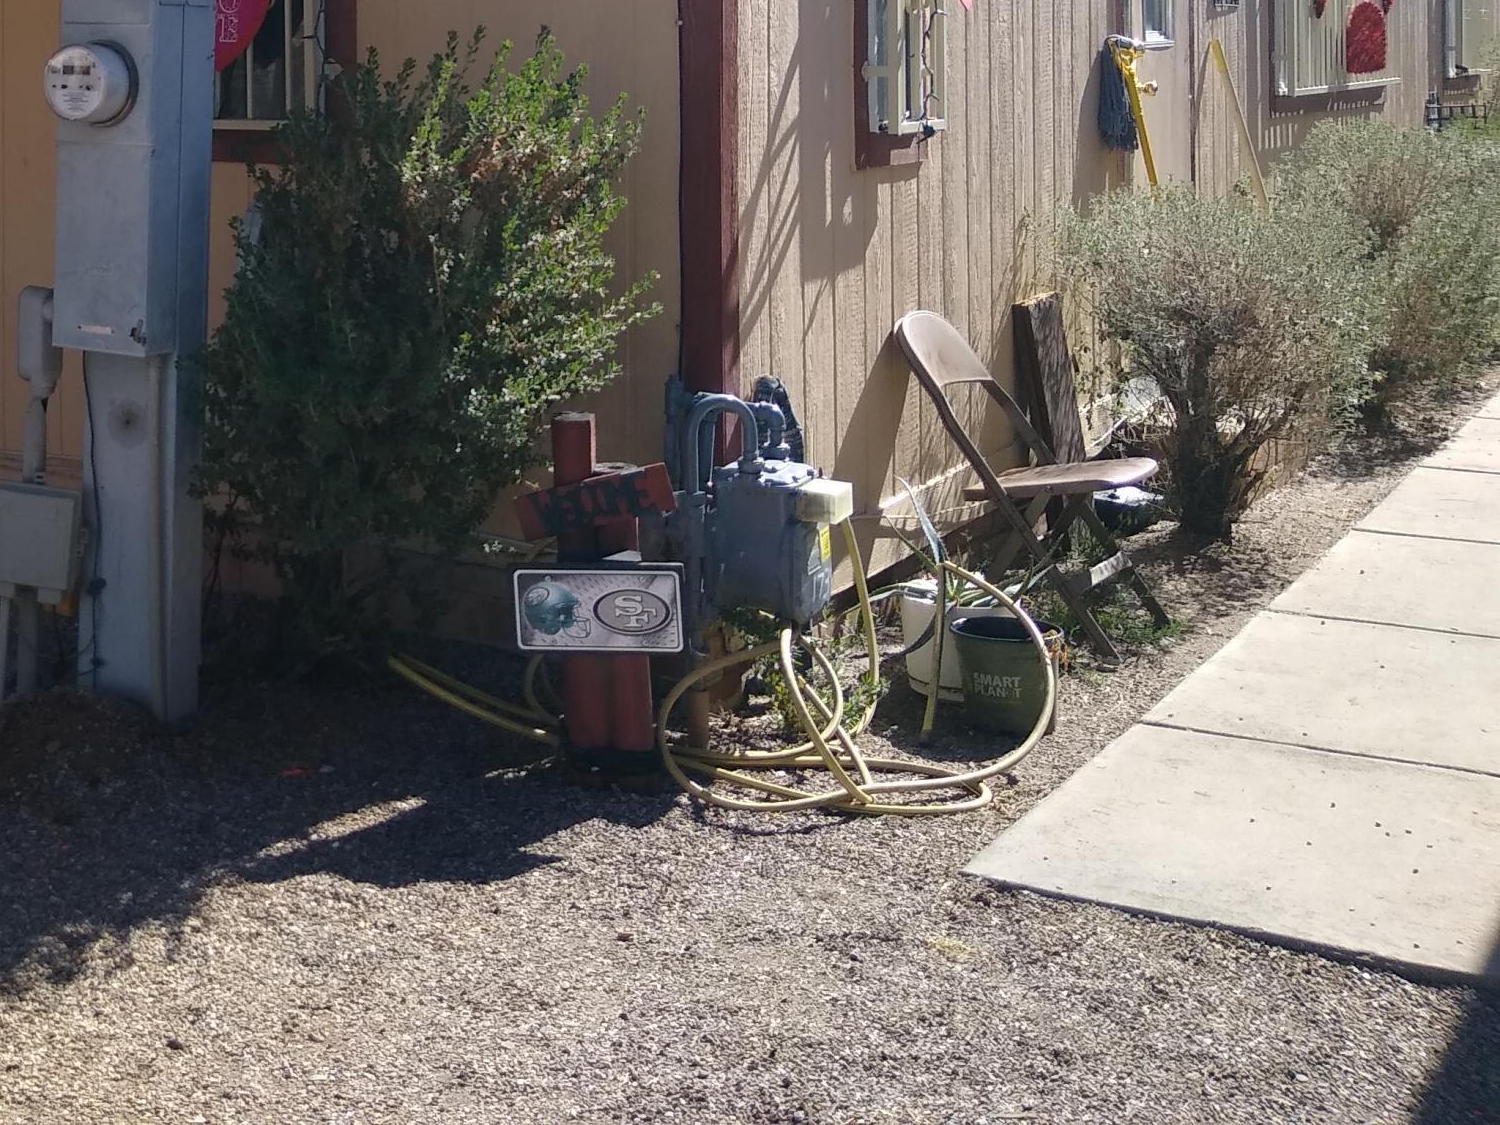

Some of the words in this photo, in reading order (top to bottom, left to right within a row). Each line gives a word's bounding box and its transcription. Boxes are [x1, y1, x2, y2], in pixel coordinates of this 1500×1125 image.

[614, 595, 657, 628] SF
[973, 671, 1021, 688] SMART
[974, 683, 1023, 699] PLANT
